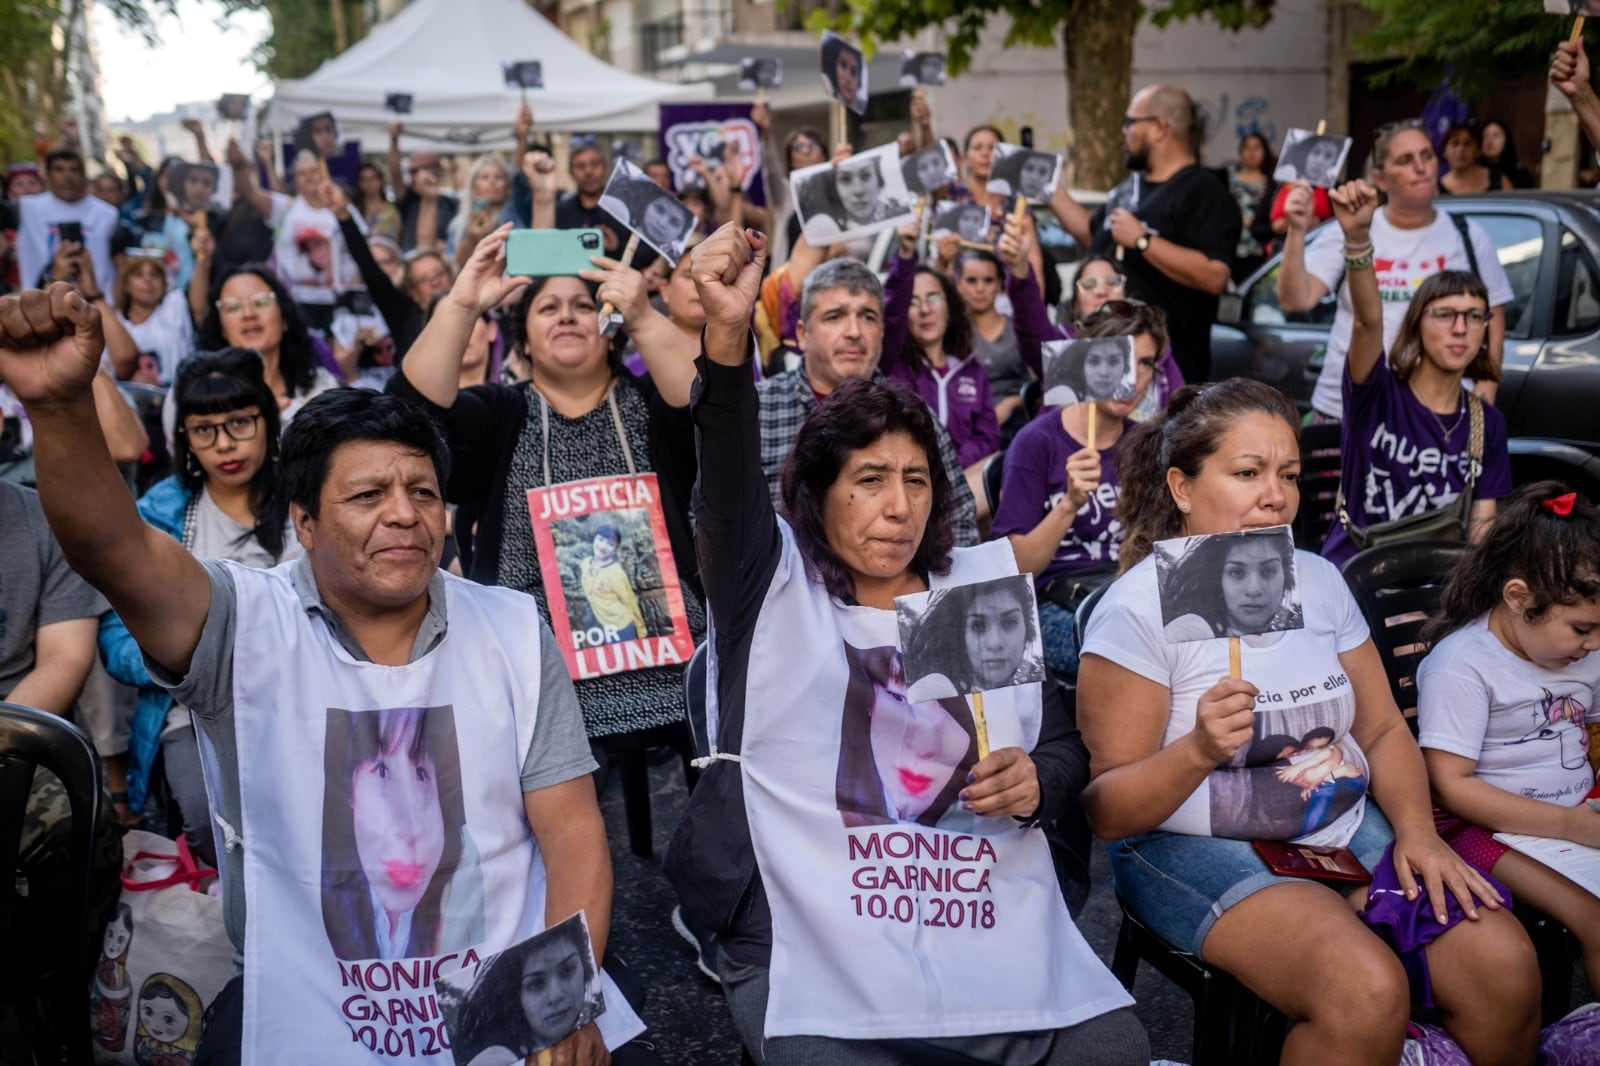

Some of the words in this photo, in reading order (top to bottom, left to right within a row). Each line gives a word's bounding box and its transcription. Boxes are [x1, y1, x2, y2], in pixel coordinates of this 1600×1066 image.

[540, 479, 653, 519] JUSTICIA
[1363, 463, 1462, 522] Evit
[572, 624, 620, 650] POR
[575, 637, 682, 679] LUNA
[1256, 691, 1283, 704] cia
[1289, 684, 1317, 703] por
[1323, 673, 1348, 692] ellos
[848, 832, 997, 864] MONICA
[852, 865, 992, 893] GARNICA
[850, 894, 996, 929] 10.0.2018
[342, 994, 440, 1025] GARNI
